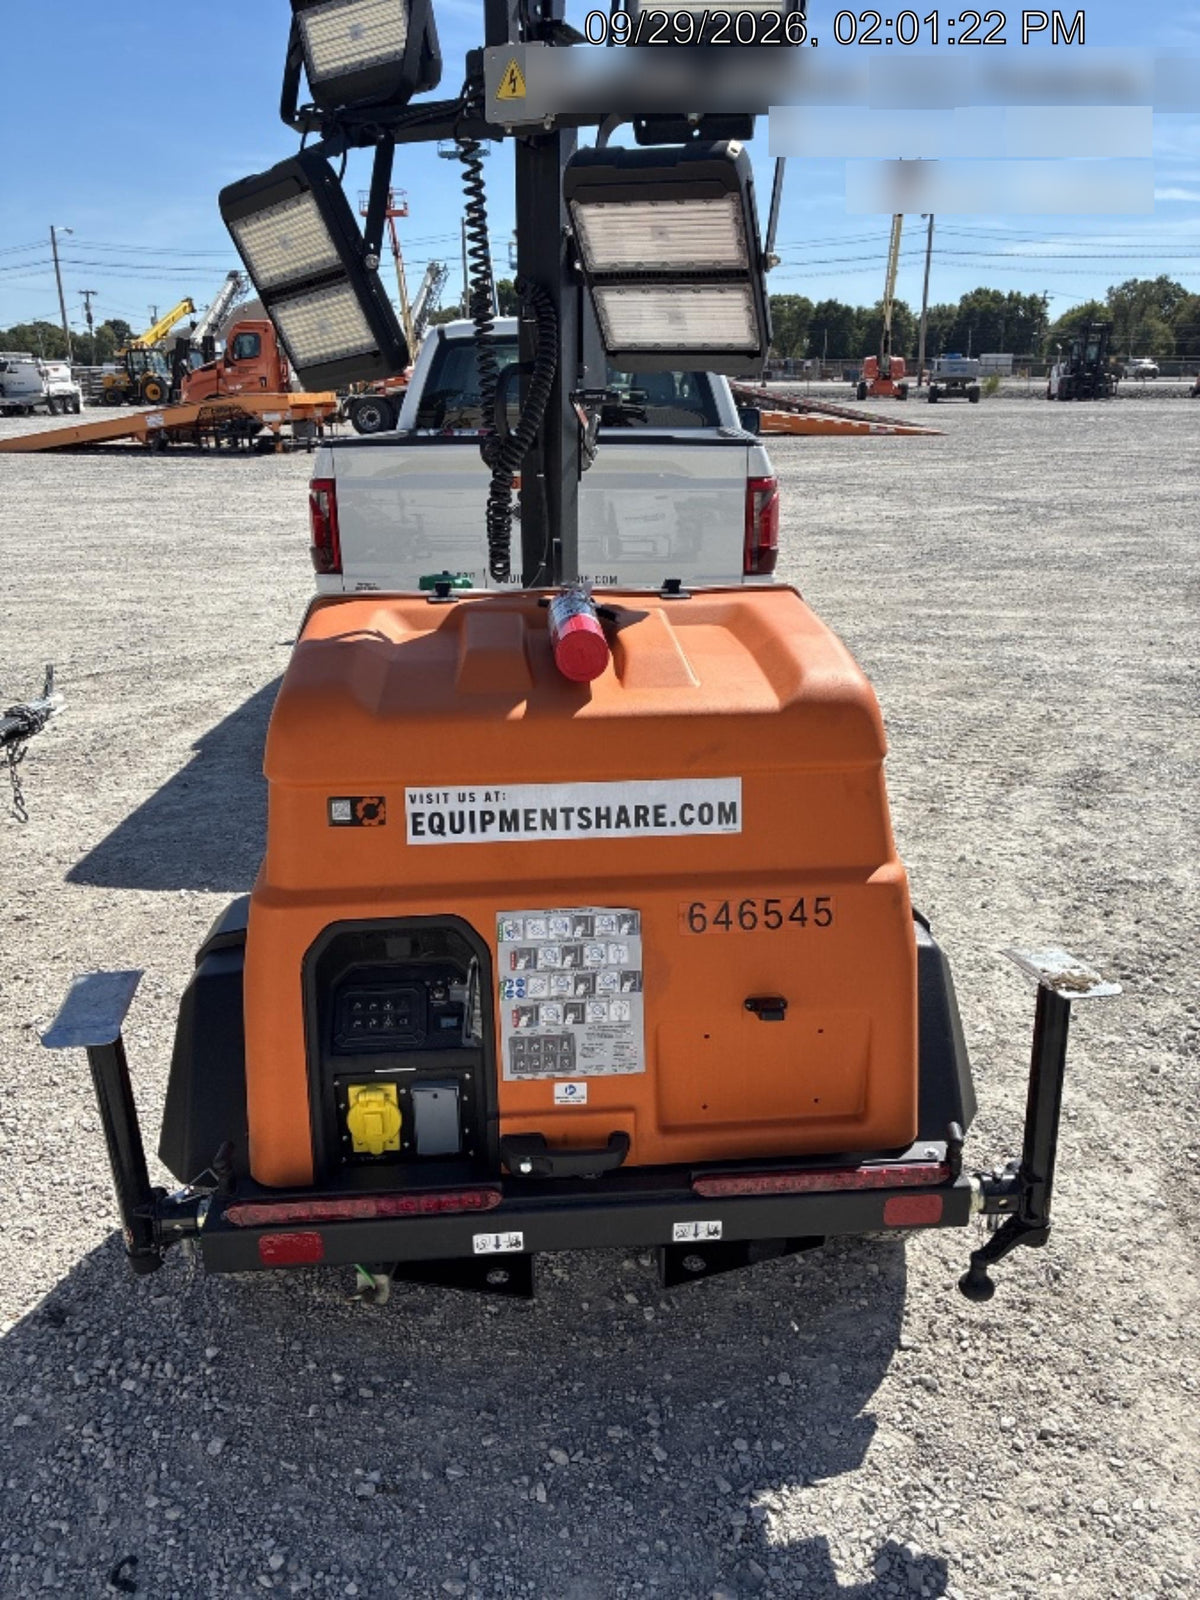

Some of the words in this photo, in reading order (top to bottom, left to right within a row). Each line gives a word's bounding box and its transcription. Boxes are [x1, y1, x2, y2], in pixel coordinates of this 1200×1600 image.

[409, 792, 450, 805] VISIT
[457, 791, 477, 804] US
[485, 790, 507, 803] AT:
[411, 802, 737, 835] EQUIPMENTSHARE.COM
[688, 896, 834, 933] 646545
